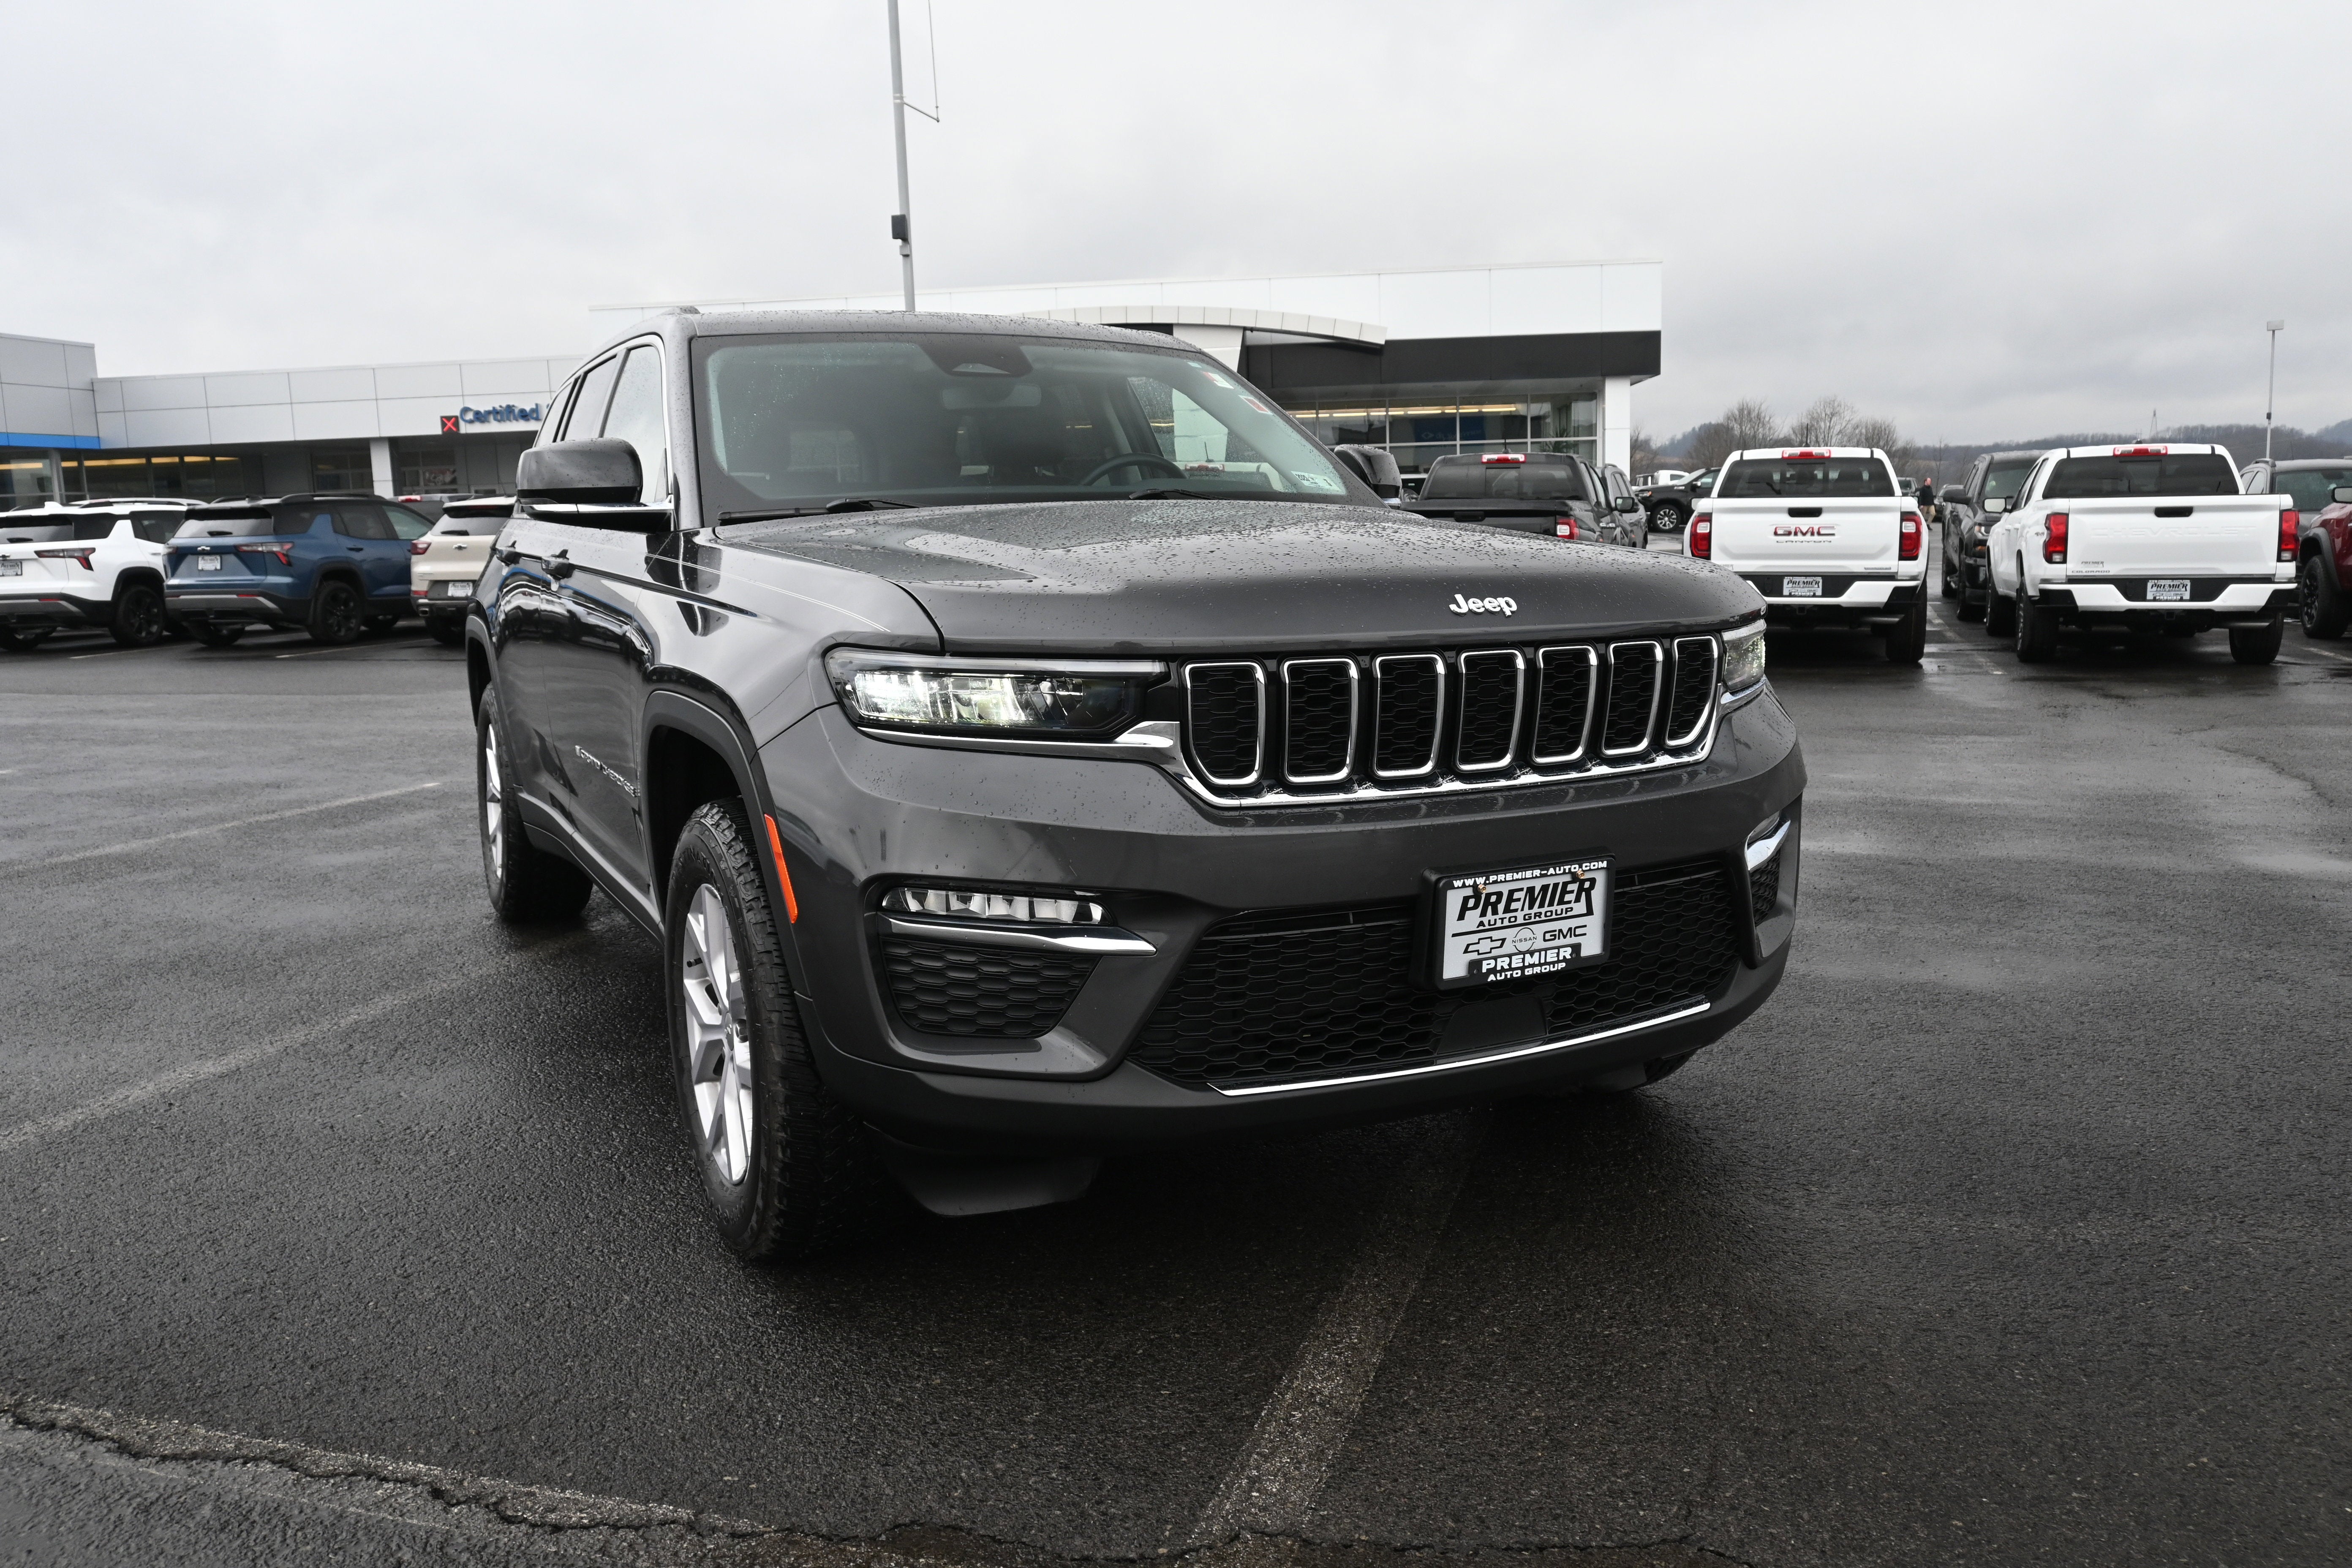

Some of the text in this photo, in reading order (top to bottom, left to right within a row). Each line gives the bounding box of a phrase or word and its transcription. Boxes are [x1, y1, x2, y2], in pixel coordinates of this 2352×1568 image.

[459, 403, 541, 423] Certified
[1774, 526, 1836, 536] GMC
[2151, 583, 2188, 591] PREMIER
[1449, 593, 1517, 617] Jeep
[1453, 860, 1608, 887] WWW.PREMIER-AUTO.COM
[1456, 877, 1597, 922] PREMIER
[1476, 906, 1574, 928] AUTO GROUP
[1512, 935, 1537, 944] NISSAN
[1543, 924, 1587, 942] GMC
[1482, 947, 1572, 973] PREMIER
[1487, 962, 1566, 982] AUTO GROUP
